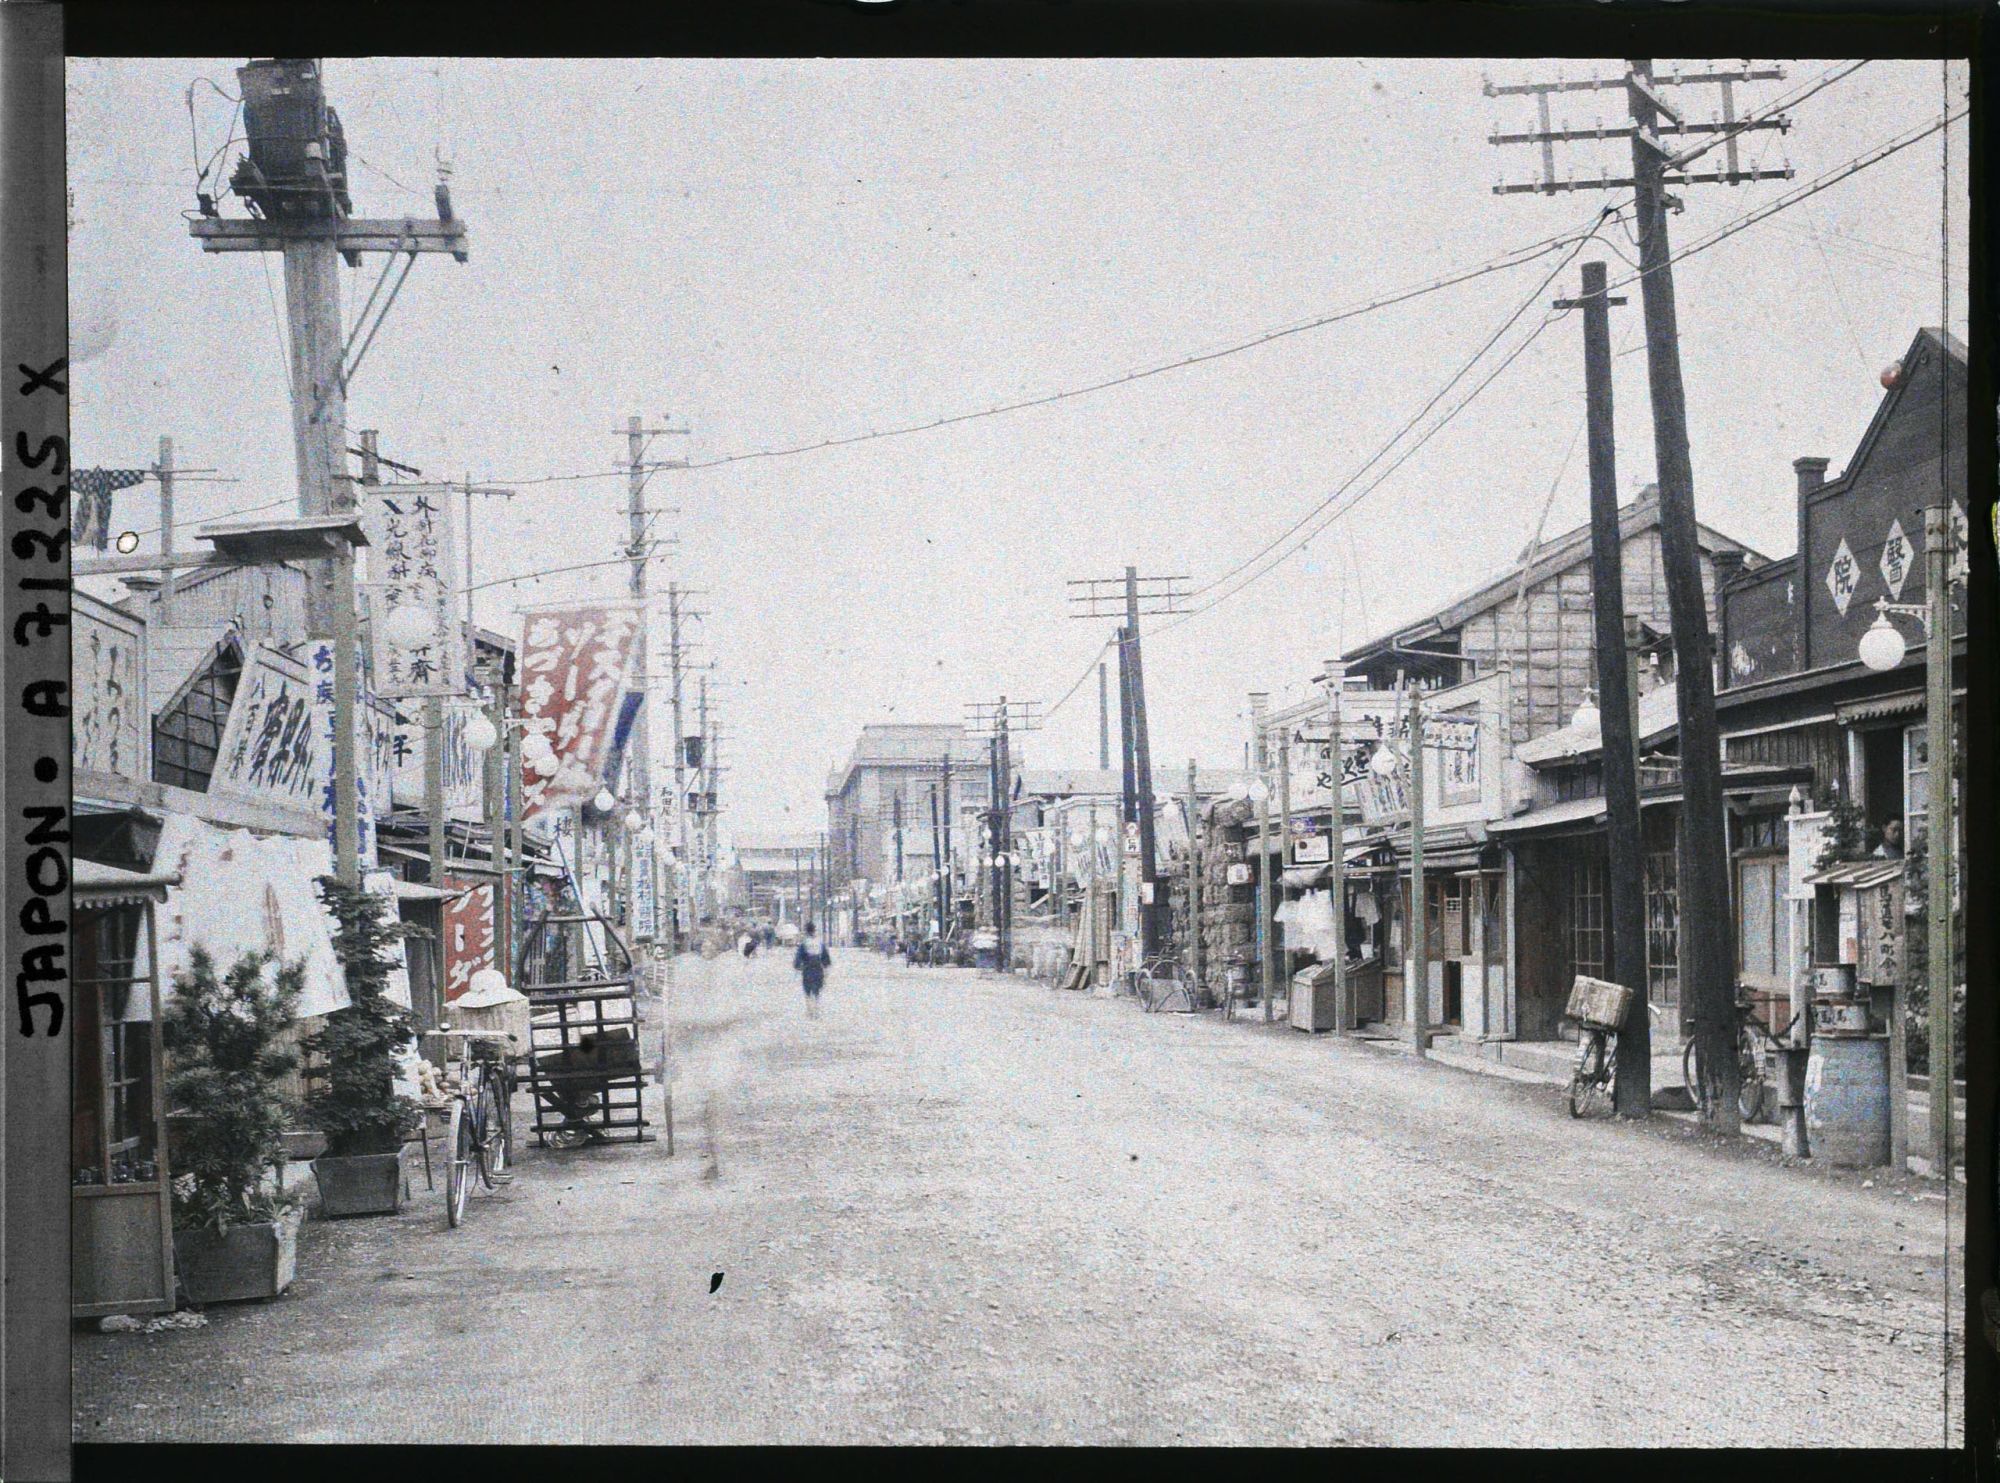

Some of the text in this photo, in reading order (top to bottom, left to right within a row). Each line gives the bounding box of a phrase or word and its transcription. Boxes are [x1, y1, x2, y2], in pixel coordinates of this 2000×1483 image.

[18, 357, 67, 397] X
[22, 679, 70, 718] A
[16, 805, 70, 1037] JAPON
